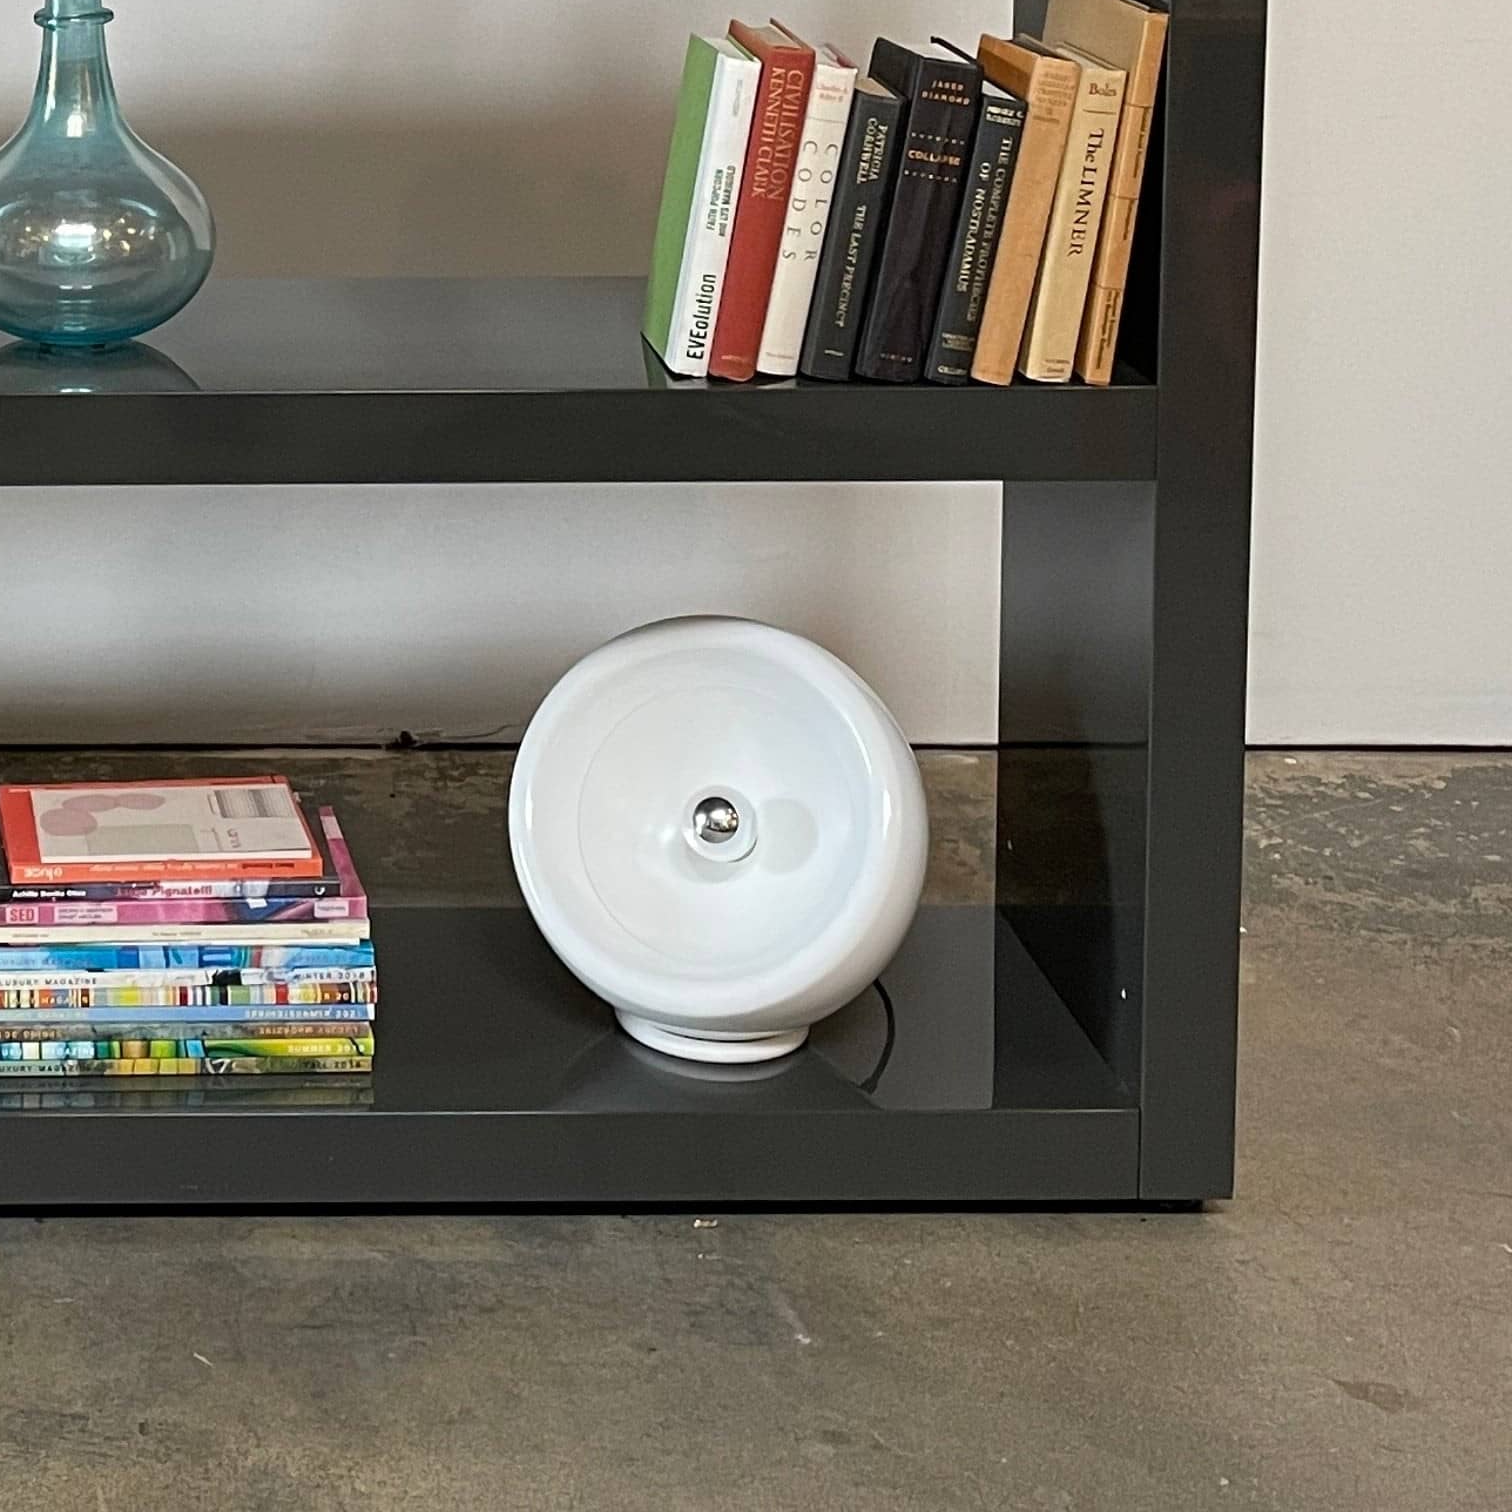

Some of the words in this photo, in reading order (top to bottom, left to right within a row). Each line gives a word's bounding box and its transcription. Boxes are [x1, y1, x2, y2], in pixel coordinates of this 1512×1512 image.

[760, 67, 786, 143] KENNETH
[768, 70, 805, 201] CIVILISATION
[856, 117, 878, 185] CORNWELL
[868, 124, 889, 181] PATRICIA
[998, 136, 1013, 165] THE
[1085, 128, 1104, 163] The
[751, 145, 773, 198] CLARK
[782, 140, 818, 260] CODES
[804, 142, 838, 261] COLOR
[978, 162, 991, 182] OF
[983, 168, 1006, 235] COMPLETE
[852, 204, 867, 230] THE
[955, 188, 986, 293] NOSTRADAMUS
[1067, 166, 1097, 257] LIMNER
[845, 232, 863, 264] LAST
[686, 274, 717, 360] EVEolution
[834, 265, 856, 328] PRECINCT
[10, 908, 35, 922] SED
[151, 885, 213, 897] Pignatelli
[44, 977, 97, 986] MAGAZINE
